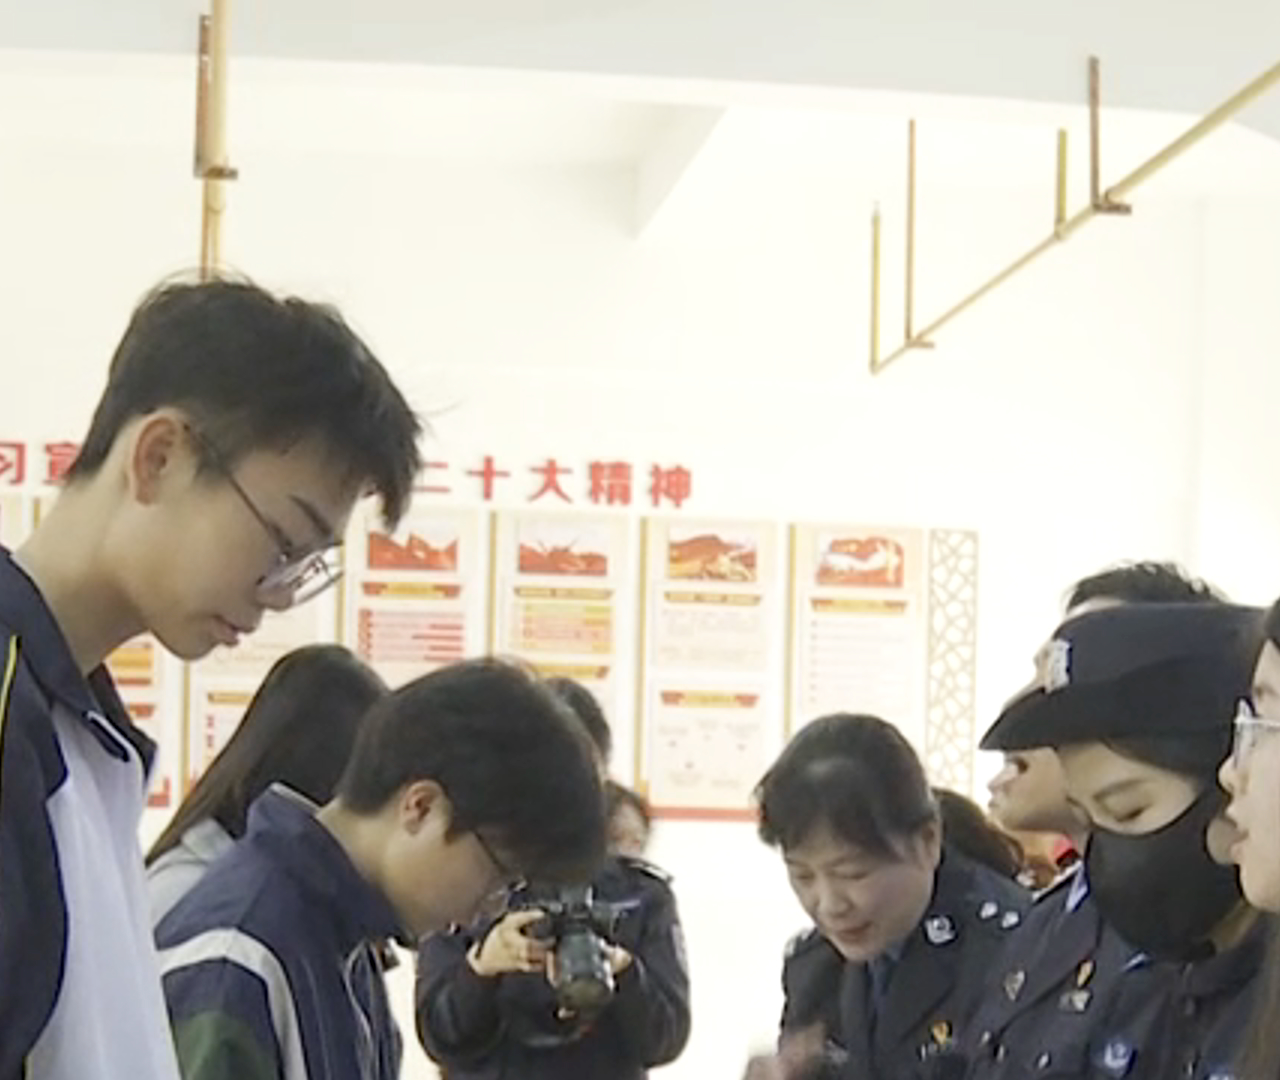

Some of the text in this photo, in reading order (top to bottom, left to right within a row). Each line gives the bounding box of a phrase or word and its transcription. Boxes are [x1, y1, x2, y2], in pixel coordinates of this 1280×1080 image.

[412, 454, 692, 509] 二十大精神
